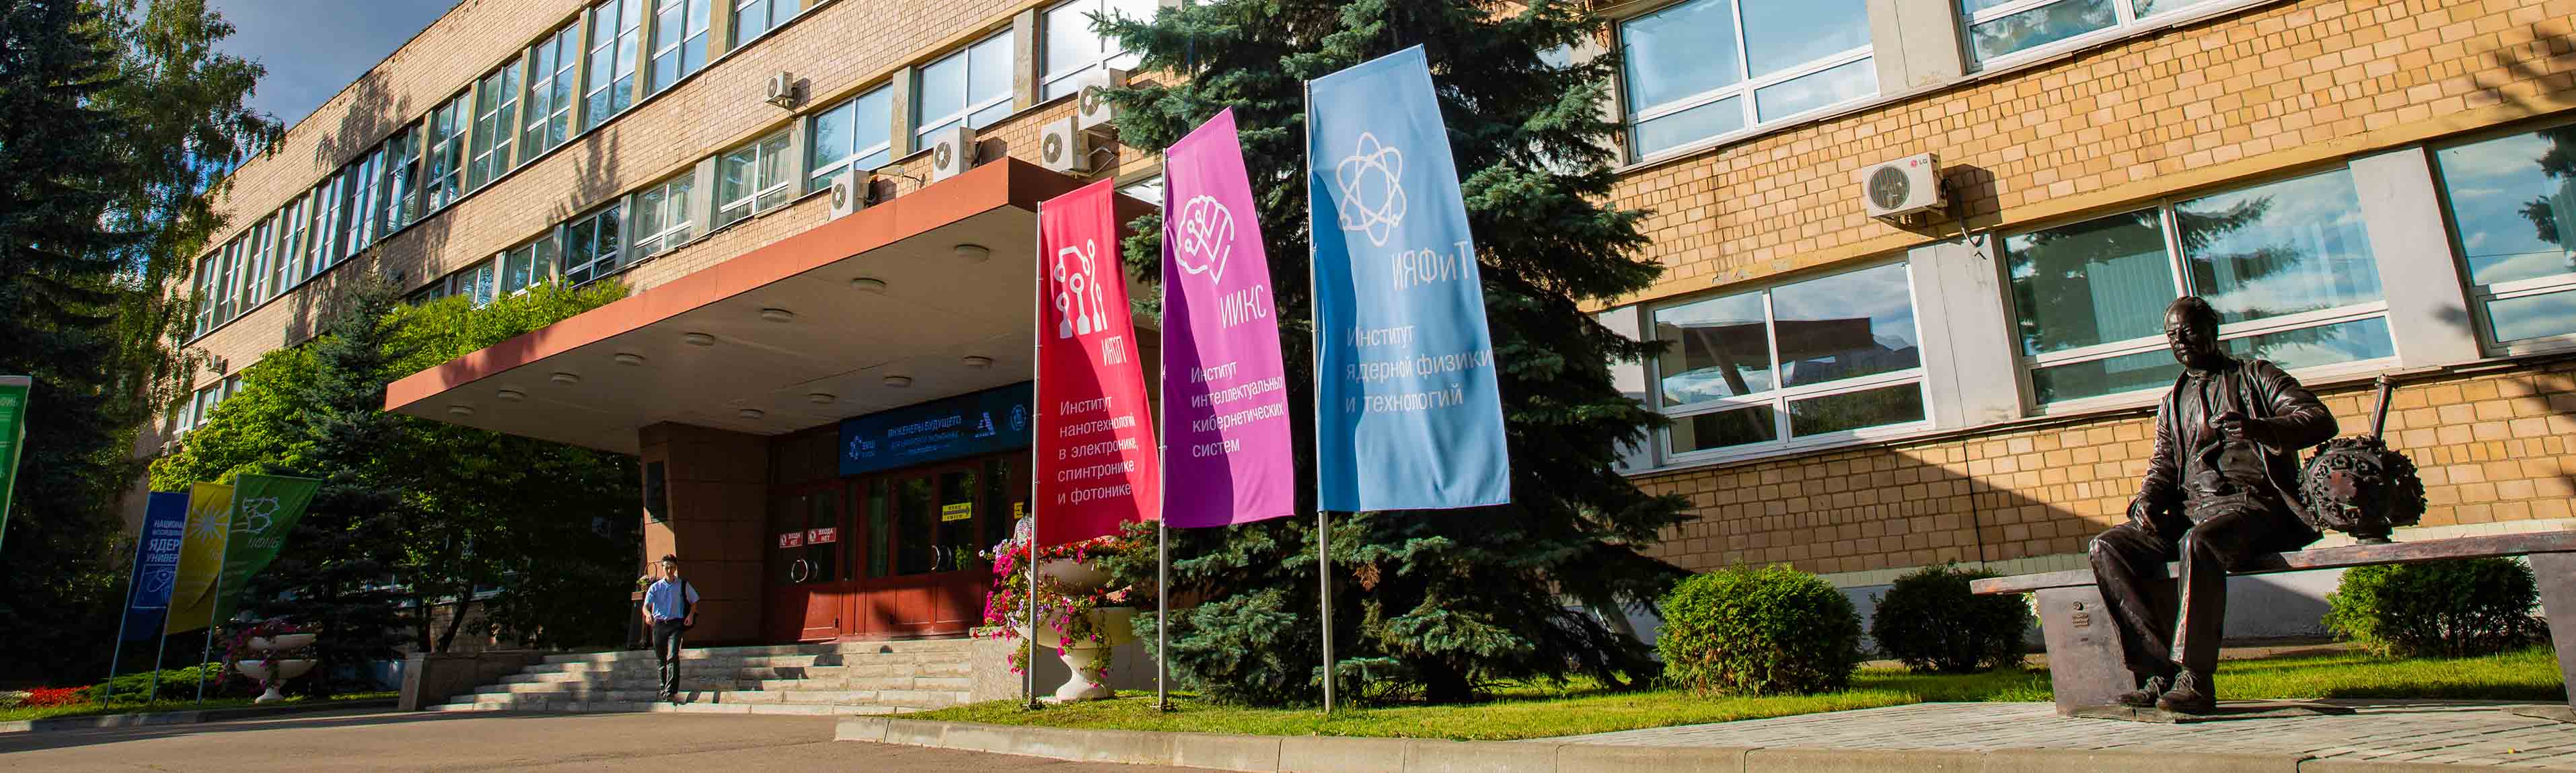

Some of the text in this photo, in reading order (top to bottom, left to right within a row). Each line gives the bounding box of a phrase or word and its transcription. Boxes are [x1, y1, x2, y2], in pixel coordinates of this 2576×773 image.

[1391, 241, 1468, 291] ИЯФиТ
[1220, 285, 1266, 328] ИИКС
[1347, 325, 1415, 348] Институт
[1191, 362, 1237, 383] Институт
[1346, 349, 1492, 384] ядерной физики
[1060, 396, 1112, 416] Институт
[1346, 383, 1464, 413] и технологий
[1192, 402, 1284, 433] кибернетических
[1059, 437, 1138, 459] в электронике,
[1192, 439, 1240, 457] систем
[1058, 460, 1134, 482] спинтронике
[1058, 484, 1131, 505] и фотонике
